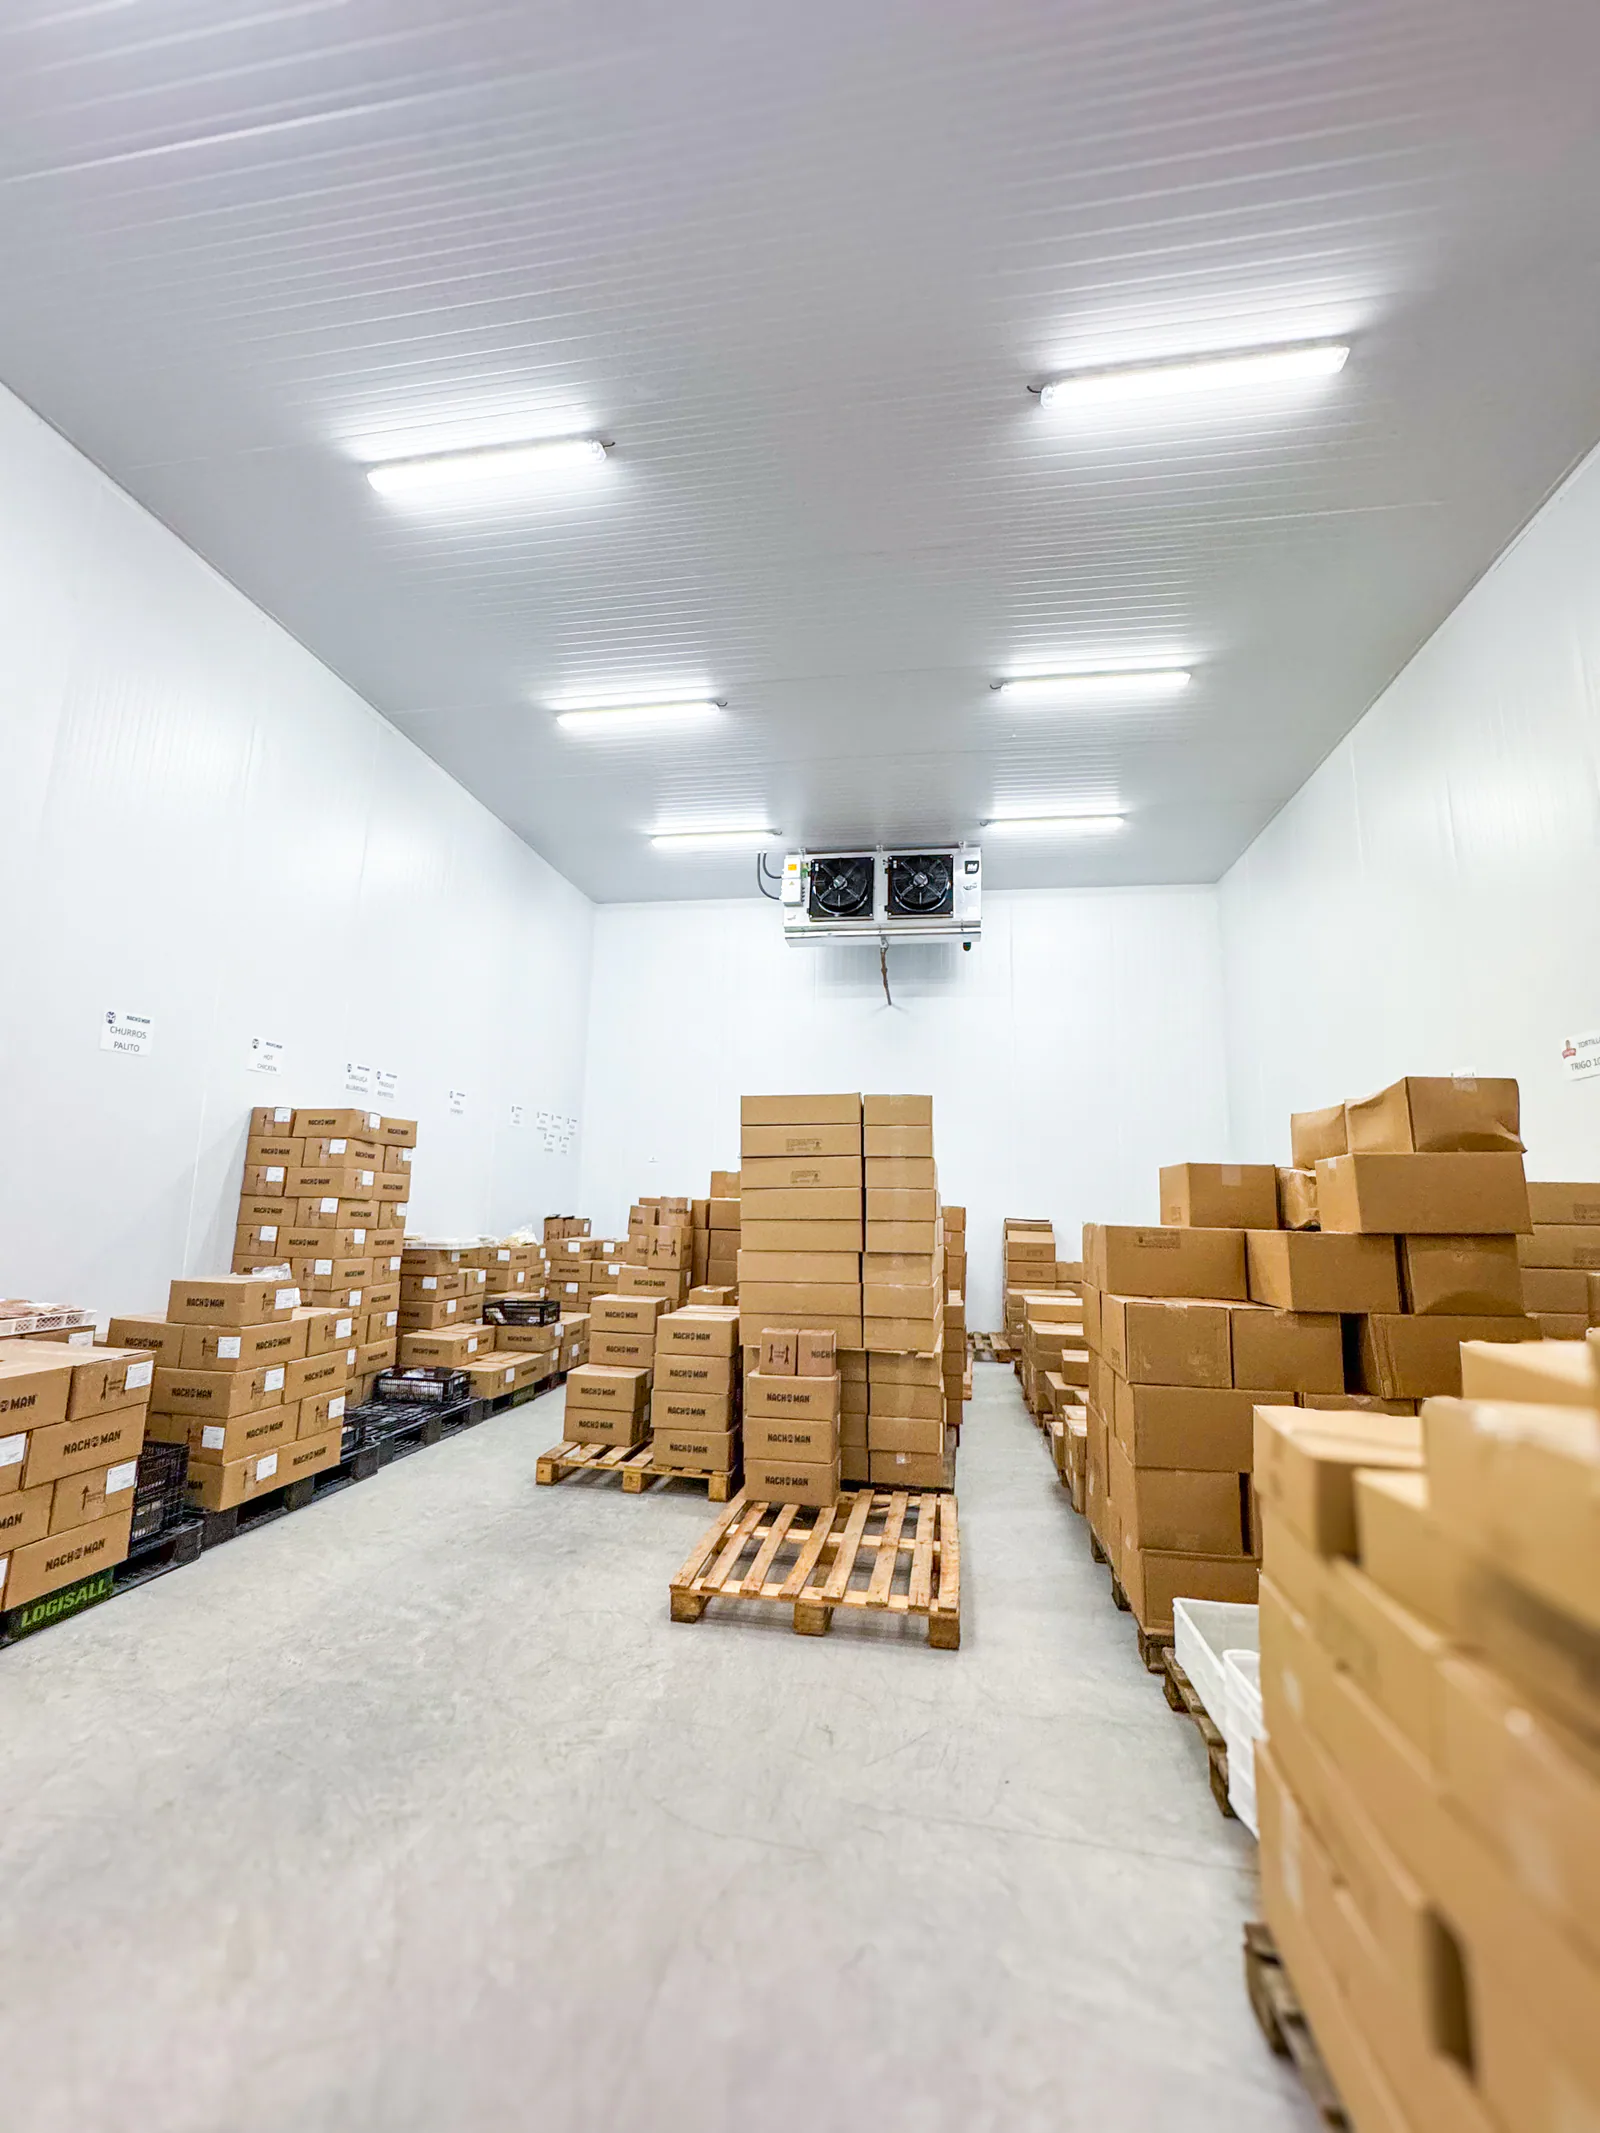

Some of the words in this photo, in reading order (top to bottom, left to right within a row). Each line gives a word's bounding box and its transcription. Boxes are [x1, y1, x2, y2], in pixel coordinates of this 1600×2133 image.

[109, 1025, 147, 1040] CHURROS
[113, 1040, 140, 1053] PALITO
[1570, 1059, 1592, 1071] TRIGO
[10, 1394, 37, 1411] MAN
[62, 1435, 100, 1456] NACHO
[100, 1430, 122, 1447] MAN
[44, 1547, 82, 1573] NACHO
[83, 1538, 107, 1557] MAN
[20, 1578, 107, 1627] LOGISALL
